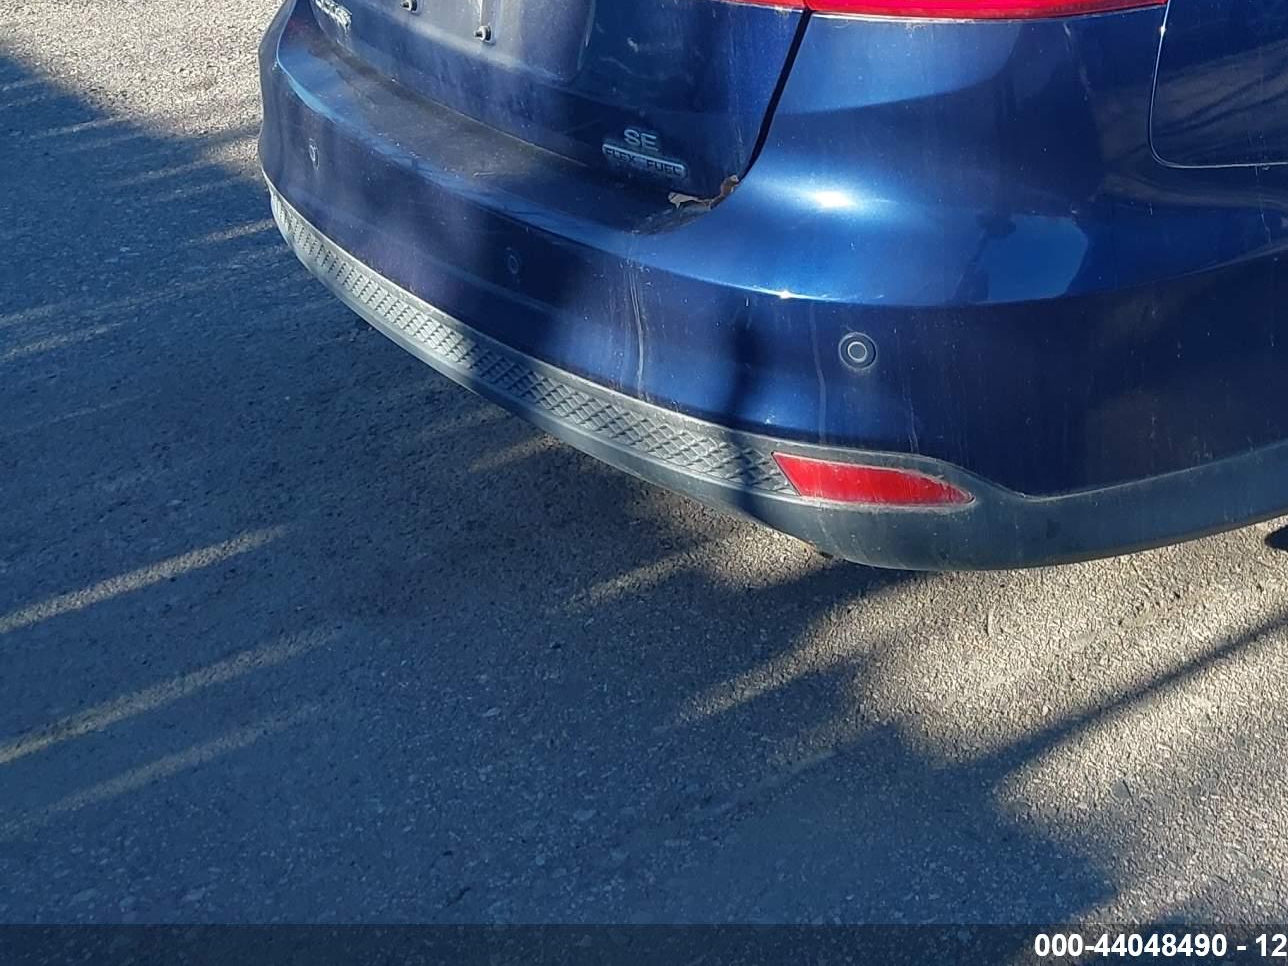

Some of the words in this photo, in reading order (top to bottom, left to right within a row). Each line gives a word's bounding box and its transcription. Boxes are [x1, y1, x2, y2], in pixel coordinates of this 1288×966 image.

[624, 129, 659, 151] SE
[605, 147, 636, 163] FLEX
[646, 159, 684, 177] FUEL
